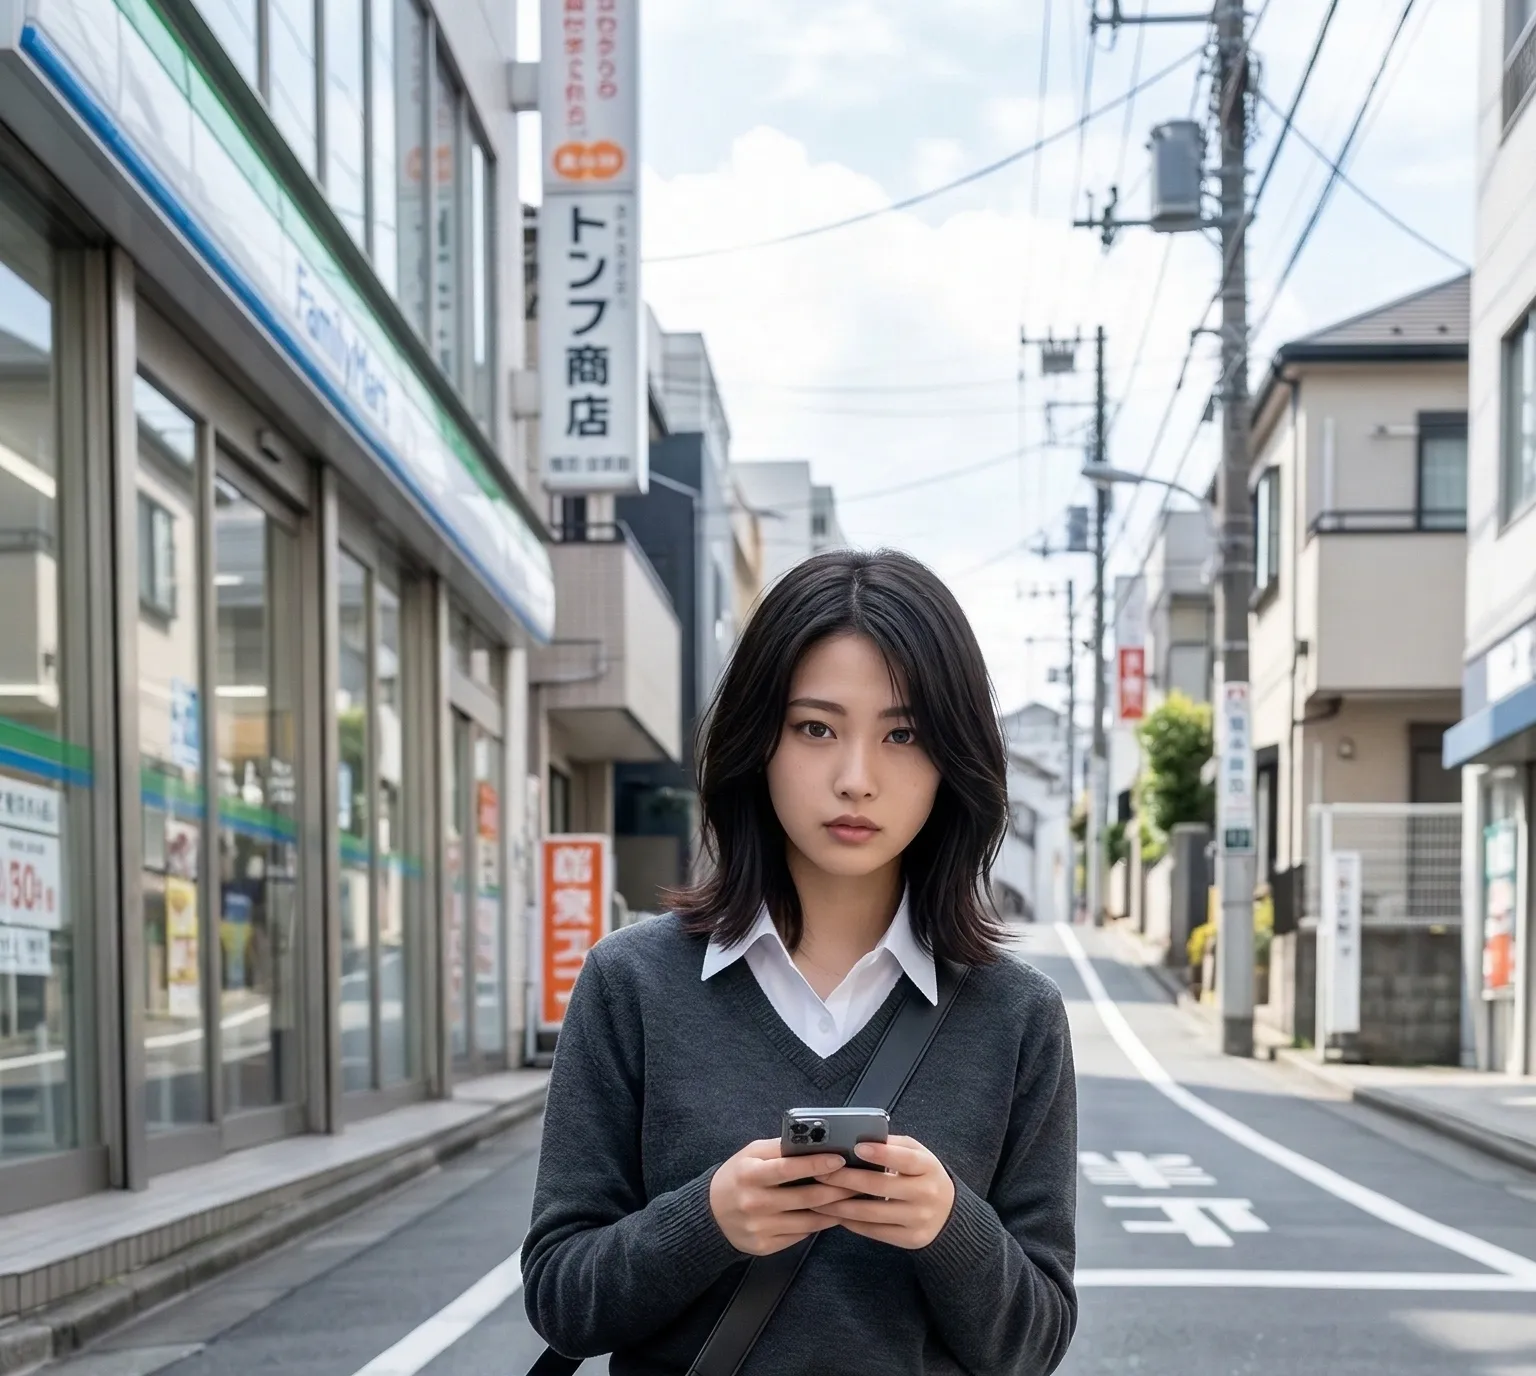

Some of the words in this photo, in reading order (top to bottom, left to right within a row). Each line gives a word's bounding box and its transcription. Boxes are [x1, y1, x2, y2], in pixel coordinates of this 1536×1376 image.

[566, 206, 609, 437] トンフ商店
